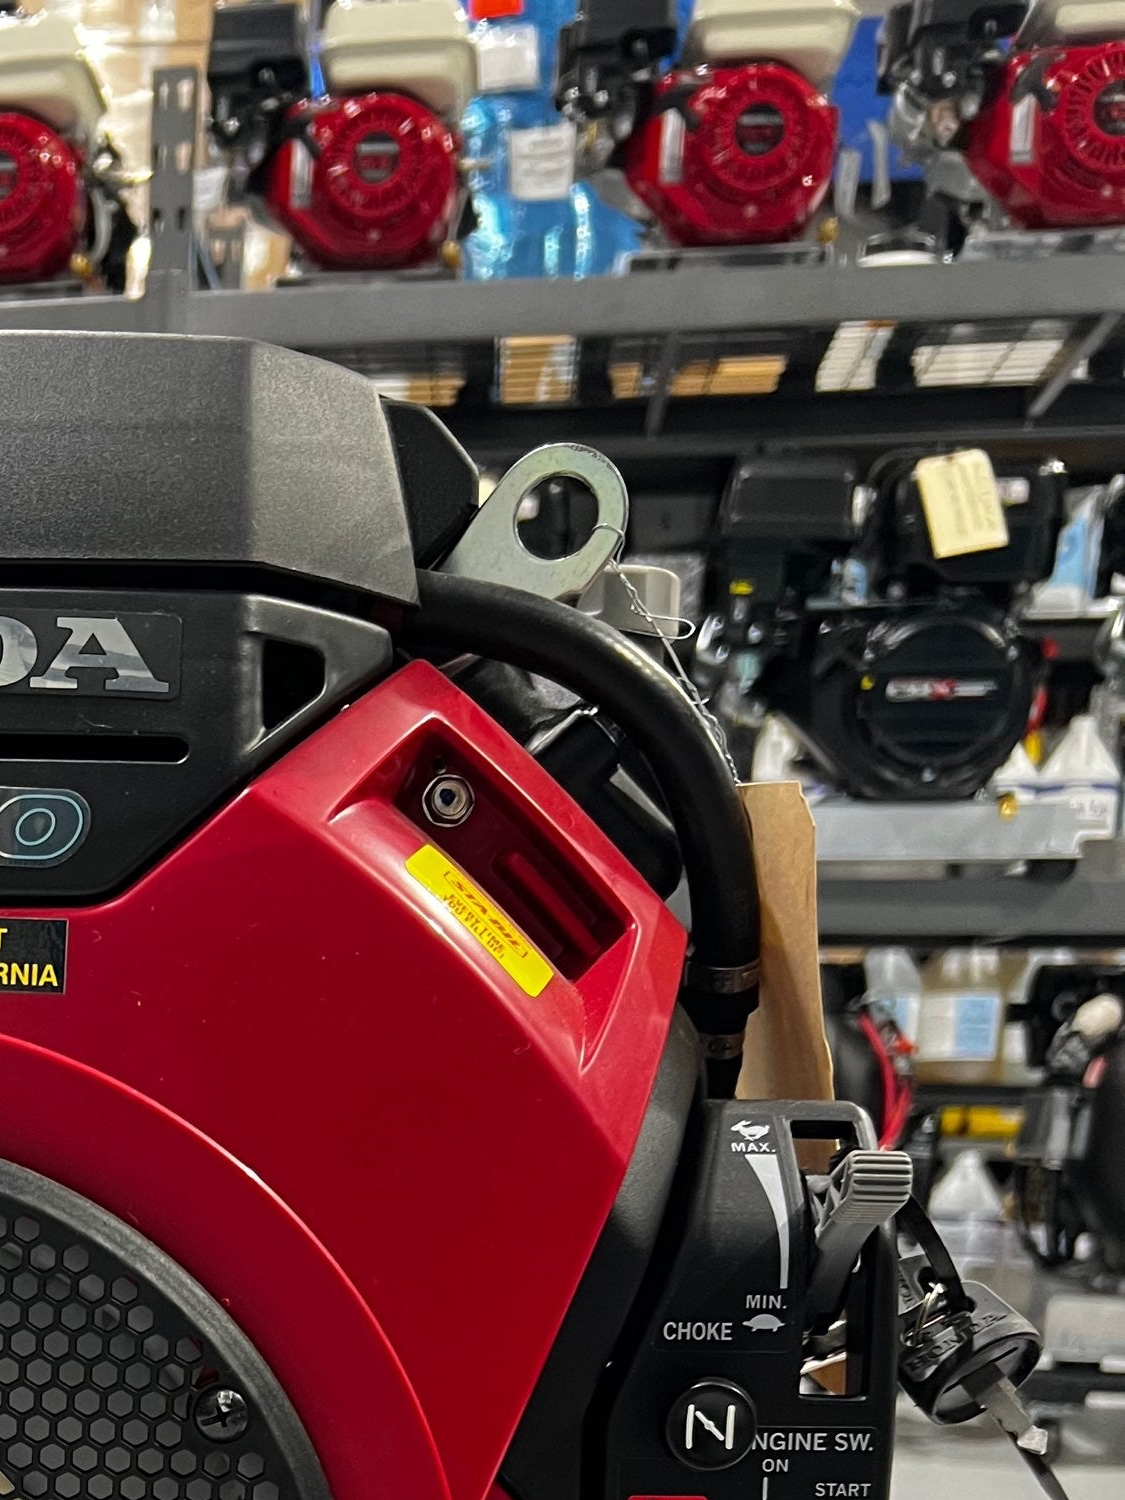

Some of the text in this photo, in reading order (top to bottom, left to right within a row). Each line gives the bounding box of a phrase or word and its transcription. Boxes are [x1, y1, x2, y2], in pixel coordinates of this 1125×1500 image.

[731, 1143, 775, 1152] MAX.
[746, 1296, 787, 1309] MIN.
[663, 1322, 732, 1341] CHOKE
[751, 1433, 874, 1452] NGINE SW.
[762, 1459, 789, 1473] ON
[815, 1484, 871, 1497] START
